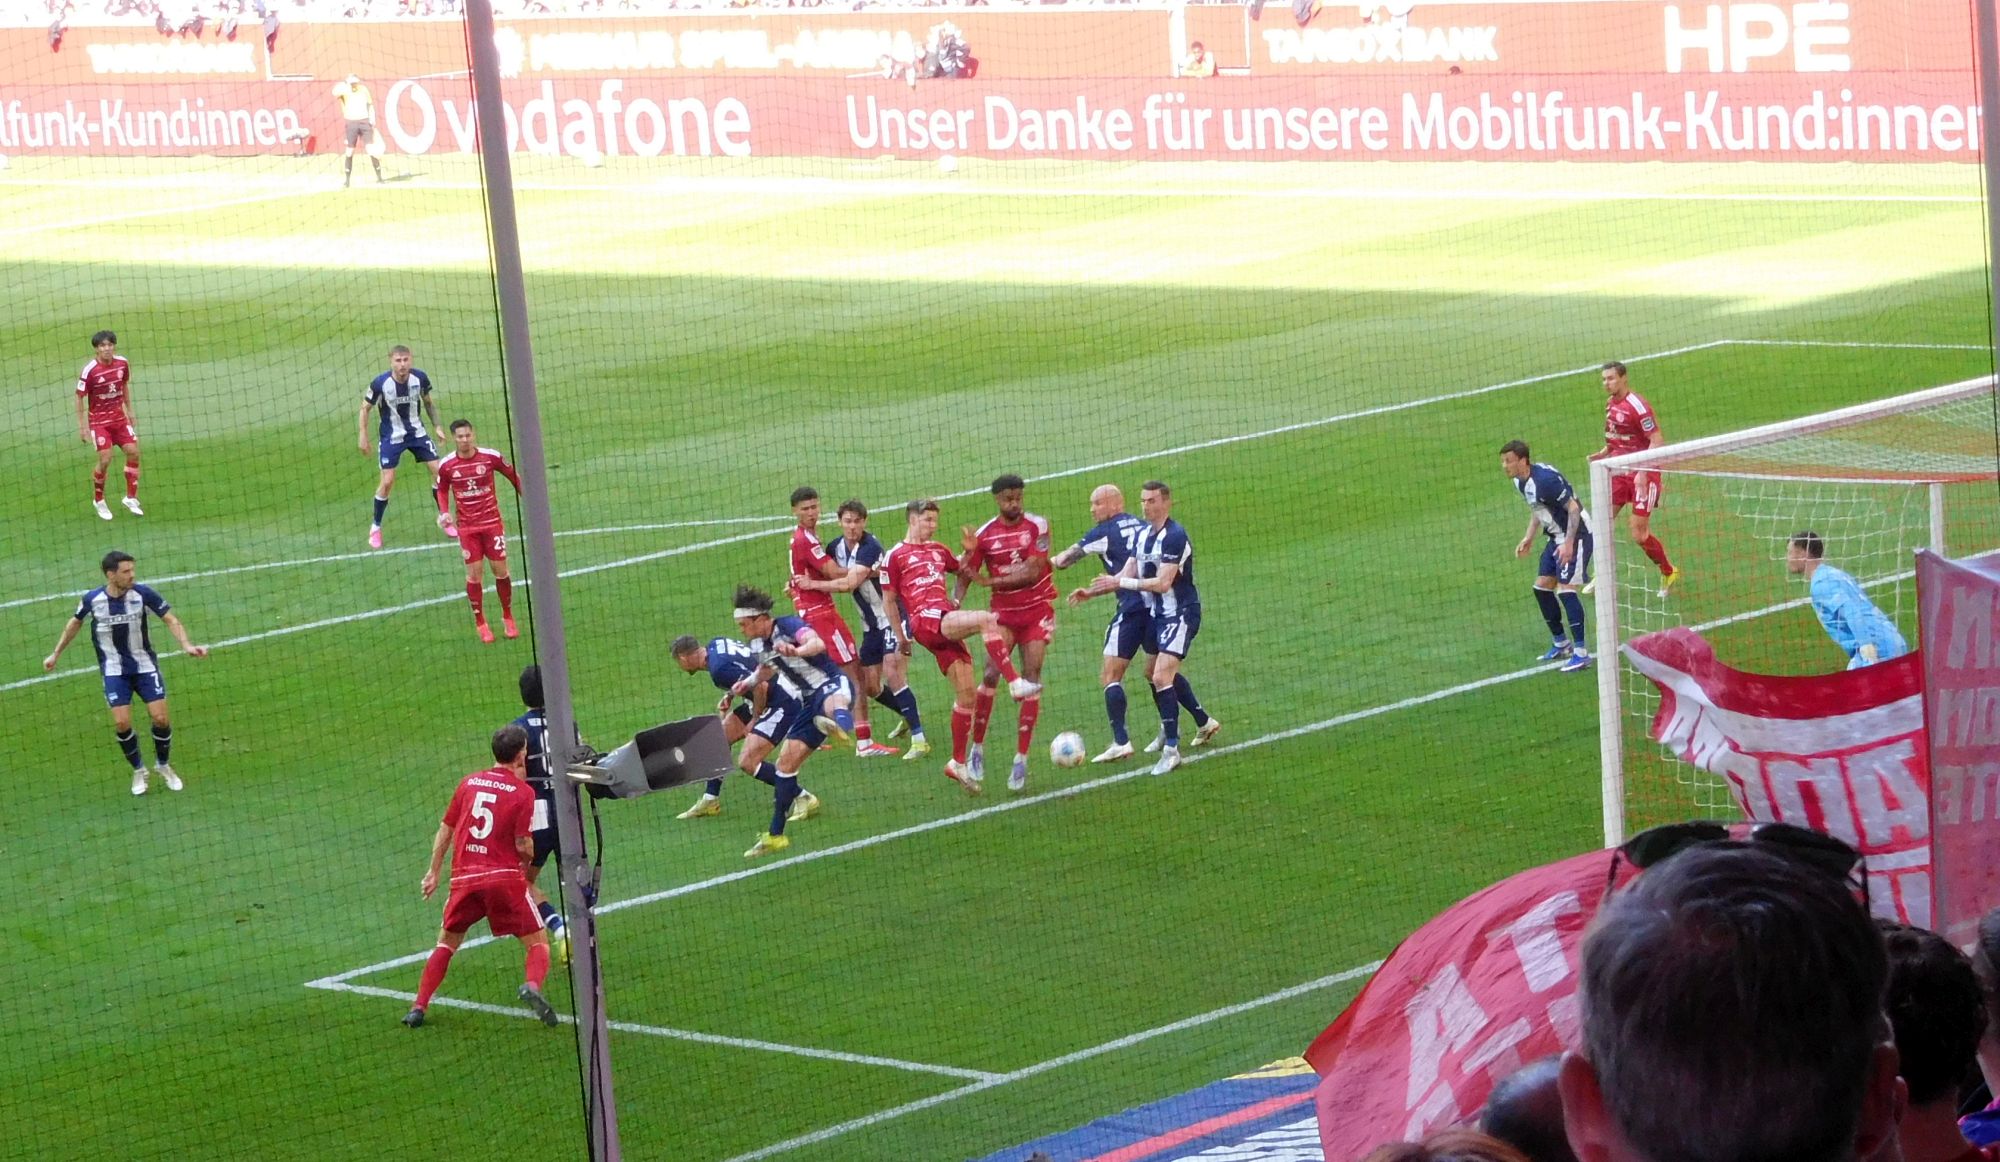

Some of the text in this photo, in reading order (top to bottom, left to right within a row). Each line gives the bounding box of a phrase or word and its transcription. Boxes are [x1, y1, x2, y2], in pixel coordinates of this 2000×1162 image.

[1664, 3, 1851, 73] HPE
[846, 95, 974, 150] Unser
[984, 95, 1133, 151] Danke
[1143, 92, 1212, 150] für
[1223, 107, 1388, 150] unsere
[150, 672, 161, 688] 7
[467, 776, 517, 793] DÜSSELDORF
[468, 791, 498, 840] 5
